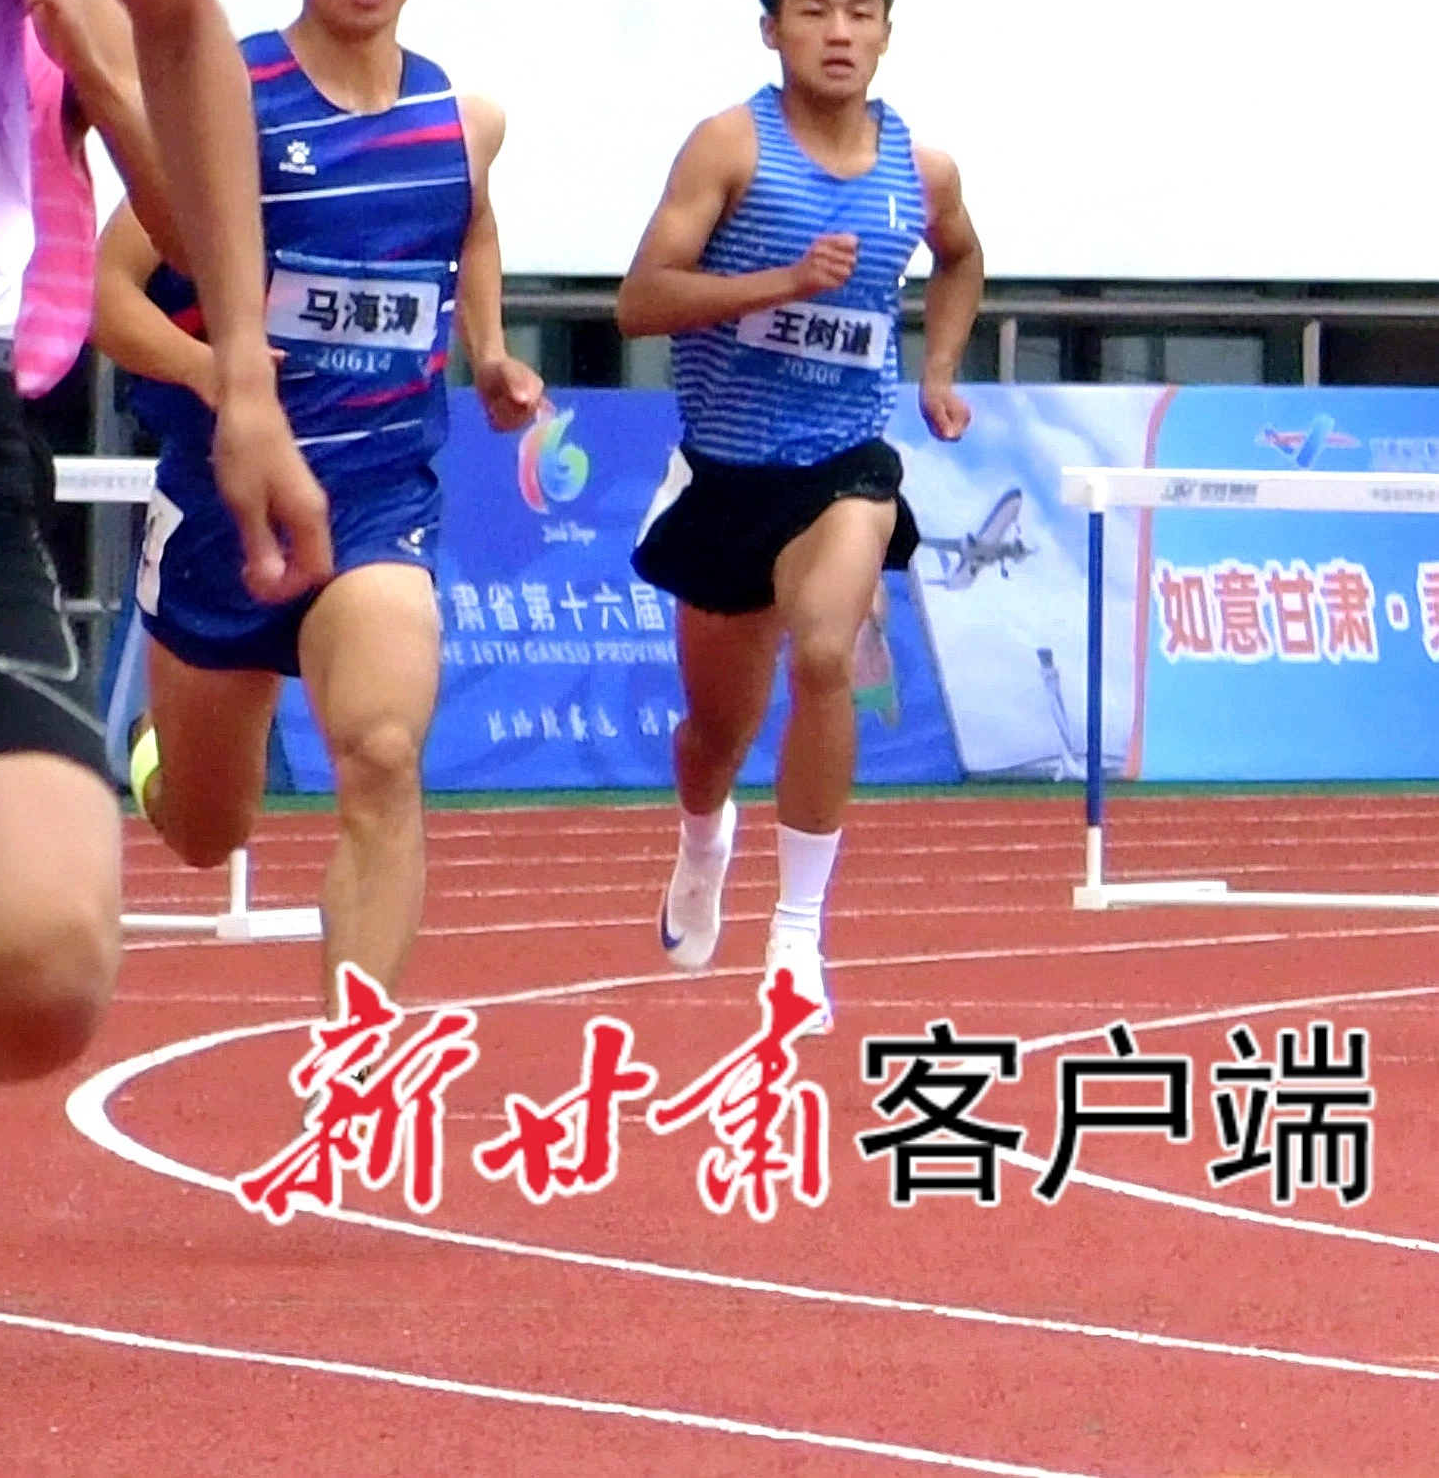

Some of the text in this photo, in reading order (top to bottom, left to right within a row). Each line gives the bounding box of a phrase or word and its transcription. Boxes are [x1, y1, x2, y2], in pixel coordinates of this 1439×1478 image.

[439, 581, 677, 632] 肃省第十六届
[473, 640, 521, 665] 16TH
[524, 640, 591, 665] GANSU
